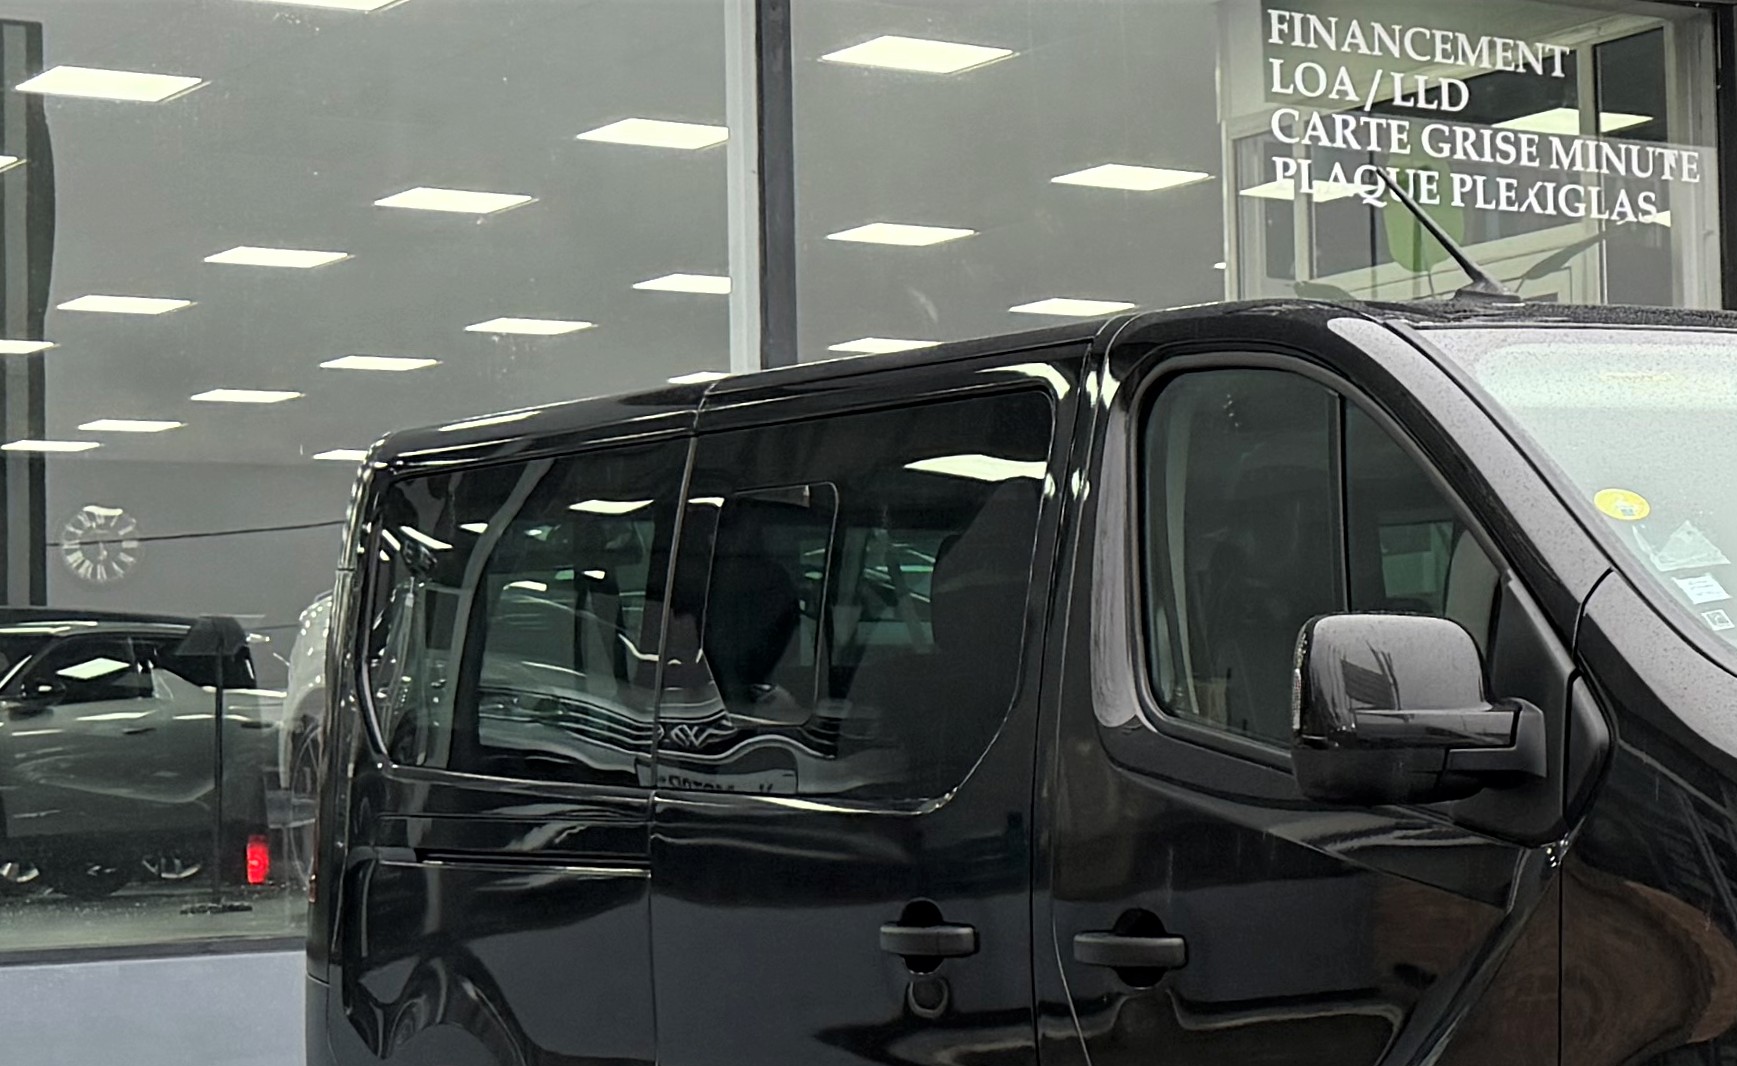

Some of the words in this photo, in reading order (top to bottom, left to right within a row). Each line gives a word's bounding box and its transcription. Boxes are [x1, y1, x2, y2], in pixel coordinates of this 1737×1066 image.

[1267, 9, 1570, 78] FINANCEMENT
[1270, 108, 1411, 155] CARTE
[1421, 123, 1540, 167] GRISE
[1549, 136, 1700, 183] MINUTE
[1272, 156, 1440, 208] PLAQUE
[1450, 172, 1658, 223] PLEXIGLAS
